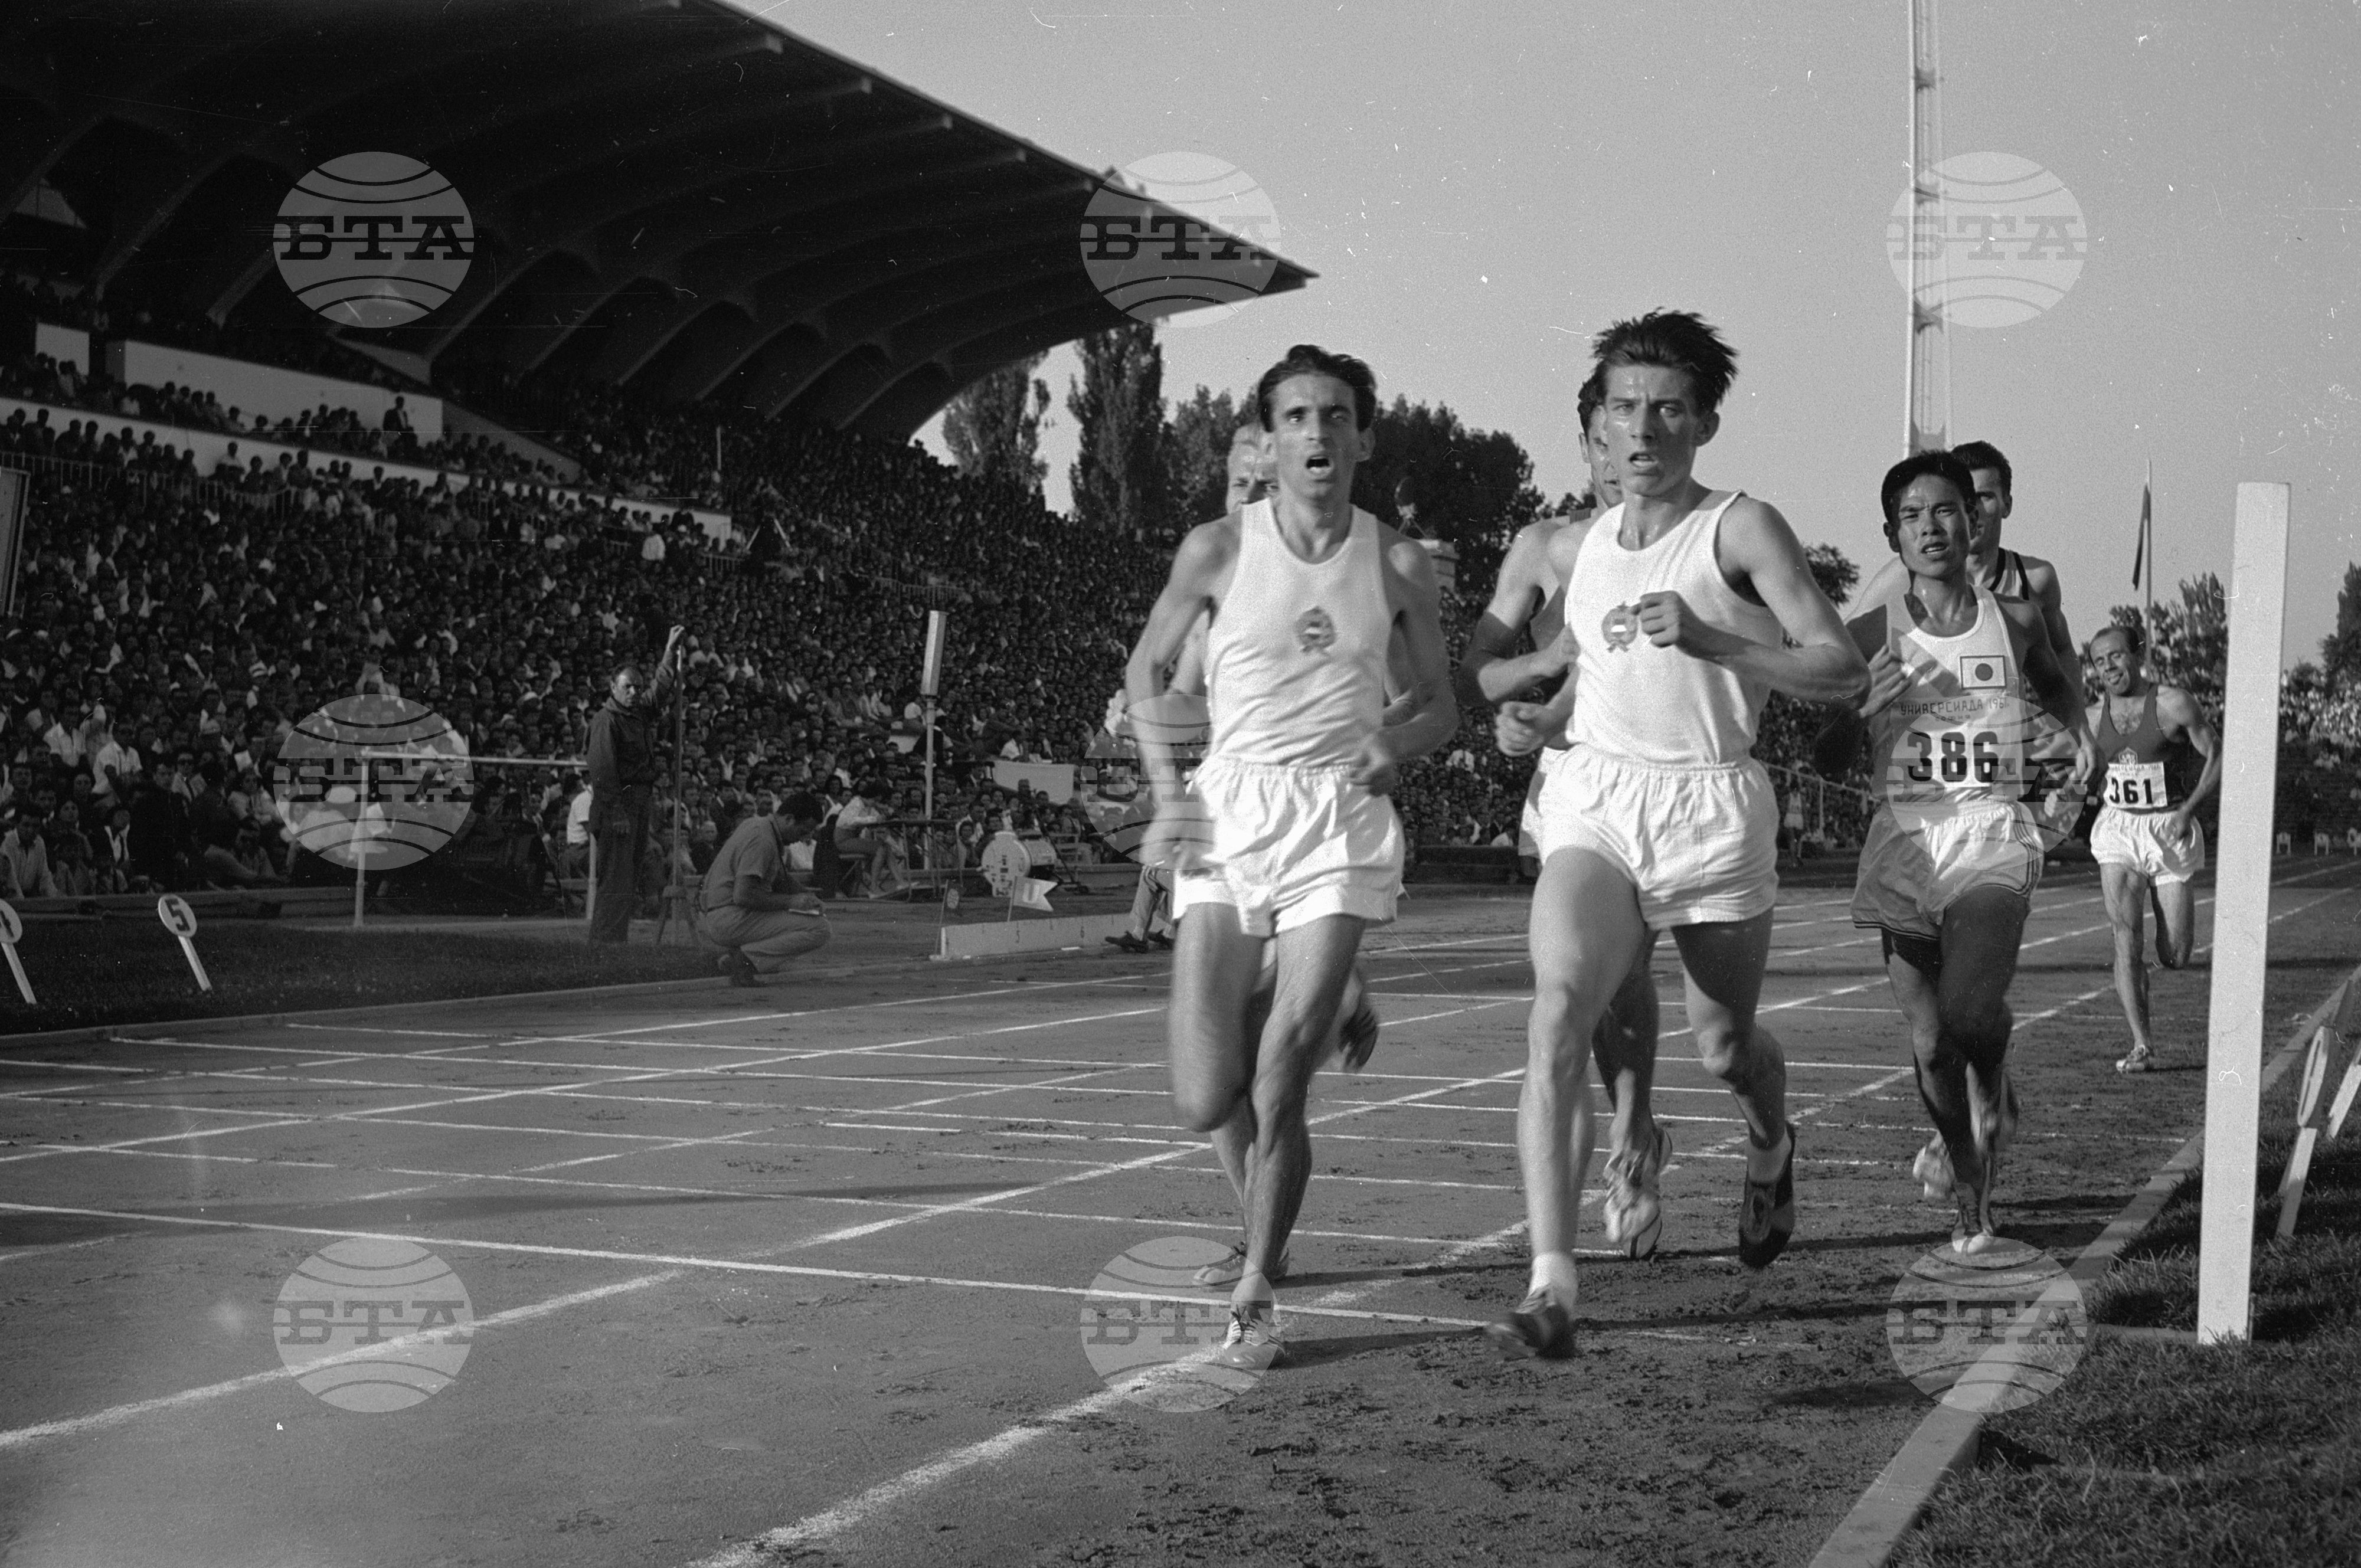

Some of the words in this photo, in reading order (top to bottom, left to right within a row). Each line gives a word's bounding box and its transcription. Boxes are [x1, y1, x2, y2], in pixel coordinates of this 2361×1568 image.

[1901, 699, 1983, 715] УНИВЕРСИАДА
[1907, 731, 1999, 783] 386
[2109, 777, 2153, 804] 361
[165, 898, 191, 931] 5
